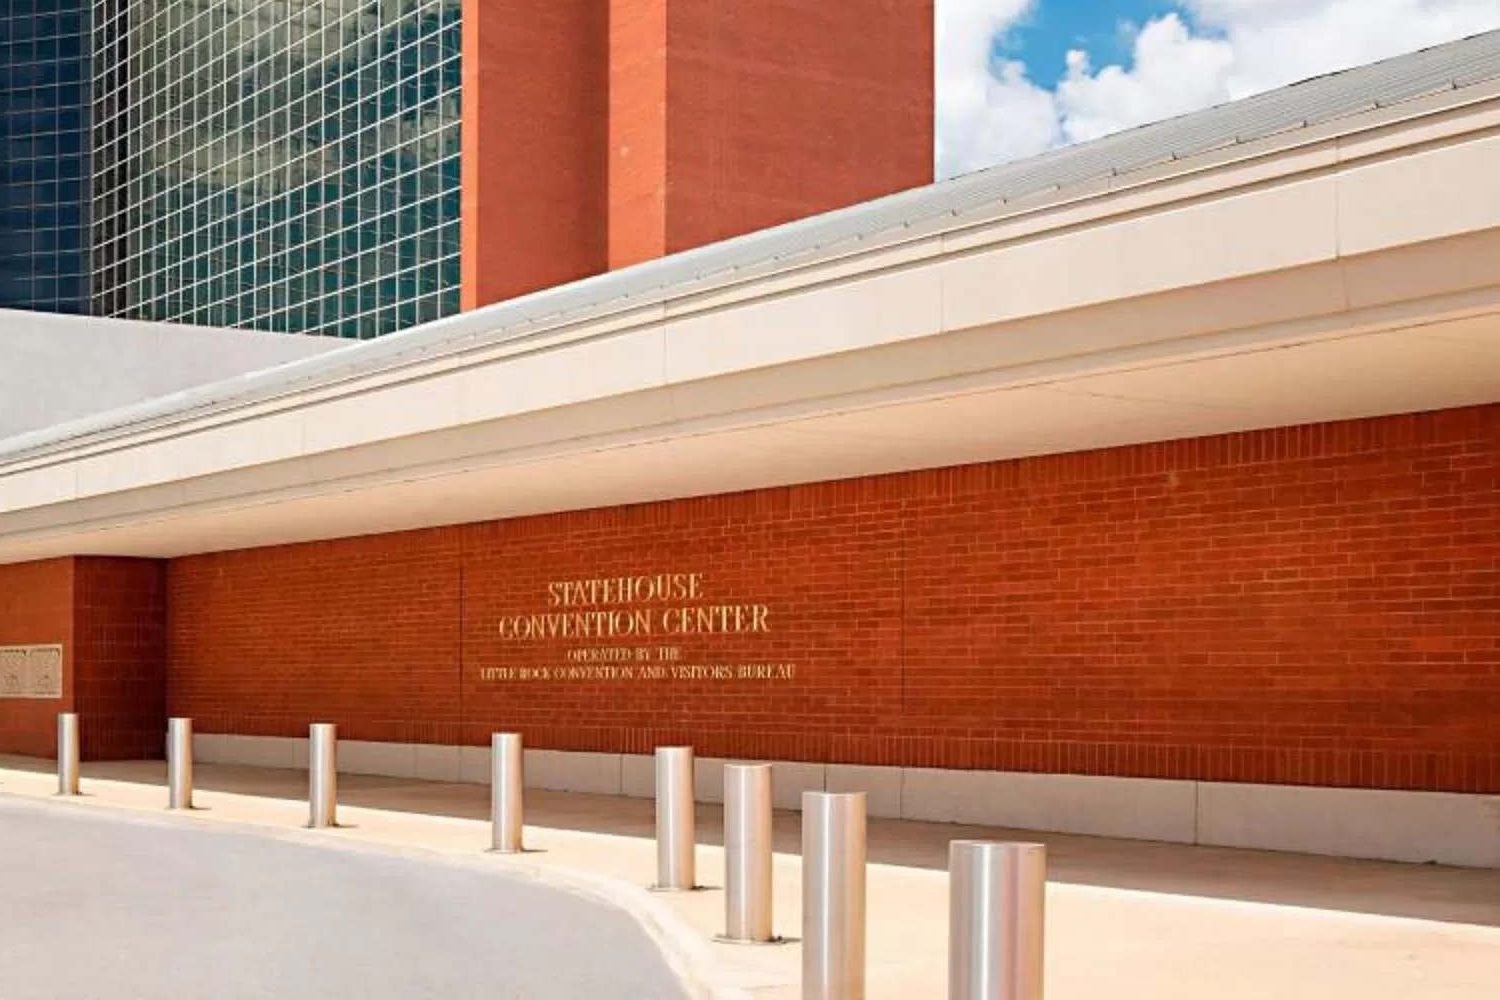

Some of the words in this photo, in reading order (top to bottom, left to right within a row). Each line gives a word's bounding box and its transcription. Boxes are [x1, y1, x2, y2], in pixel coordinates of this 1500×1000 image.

[547, 572, 704, 608] STATEHOUSE
[499, 607, 651, 641] CONVENTION
[662, 603, 771, 634] CENTER
[567, 647, 632, 662] OPERATED
[553, 665, 633, 680] CONVENTION
[638, 664, 666, 679] AND
[671, 663, 733, 679] VISITORS
[737, 662, 796, 679] BUREAU
